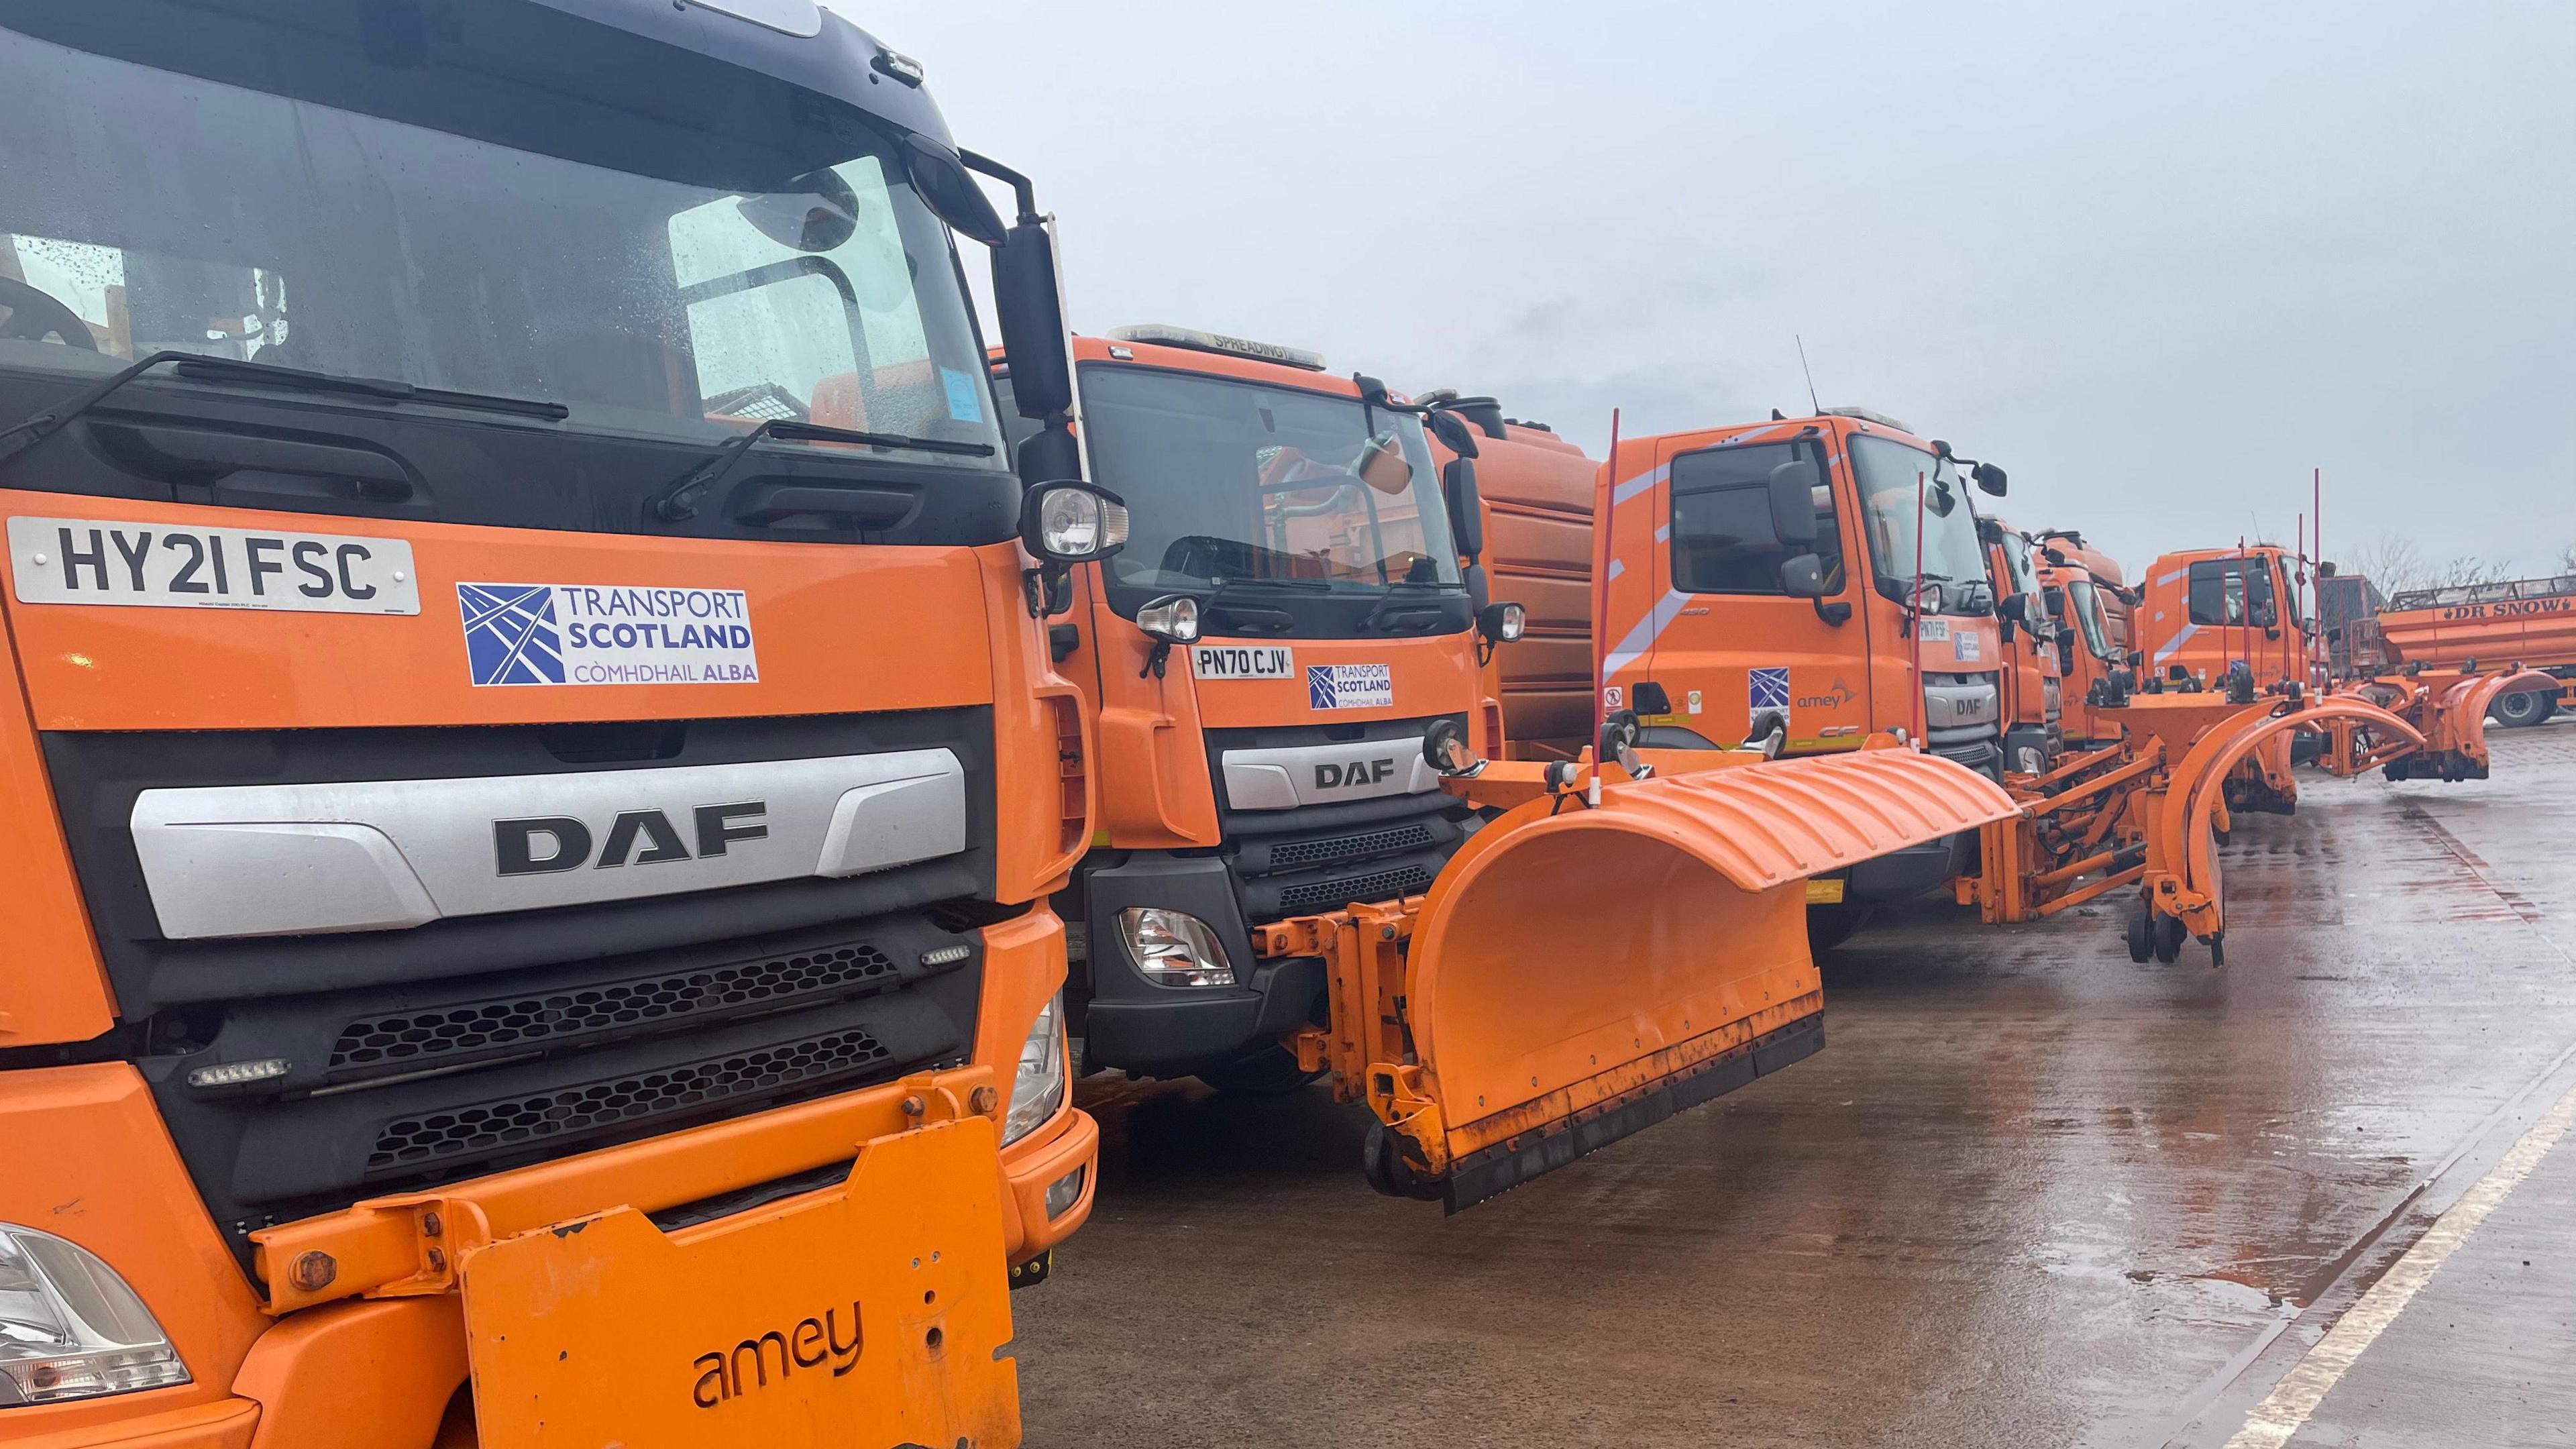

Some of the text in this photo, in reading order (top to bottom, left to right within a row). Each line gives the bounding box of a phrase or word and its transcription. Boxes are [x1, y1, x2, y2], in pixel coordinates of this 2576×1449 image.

[1213, 335, 1284, 358] SPREADING
[58, 527, 377, 600] HY21 FSC
[561, 587, 745, 618] TRANSPORT
[2455, 598, 2561, 619] DR SNOW
[568, 623, 751, 649] SCOTLAND
[574, 660, 757, 683] CÒMHDHAIL ALBA
[1199, 649, 1285, 674] PN70 CJV
[1335, 665, 1389, 679] TRANSPORT
[1337, 680, 1391, 693] SCOTLAND
[1376, 697, 1392, 706] ALBA
[1797, 695, 1840, 709] amey
[1956, 698, 1981, 716] DAF
[1819, 725, 1859, 737] CF
[1315, 758, 1394, 790] DAF
[492, 799, 769, 877] DAF
[692, 1300, 865, 1409] amey
